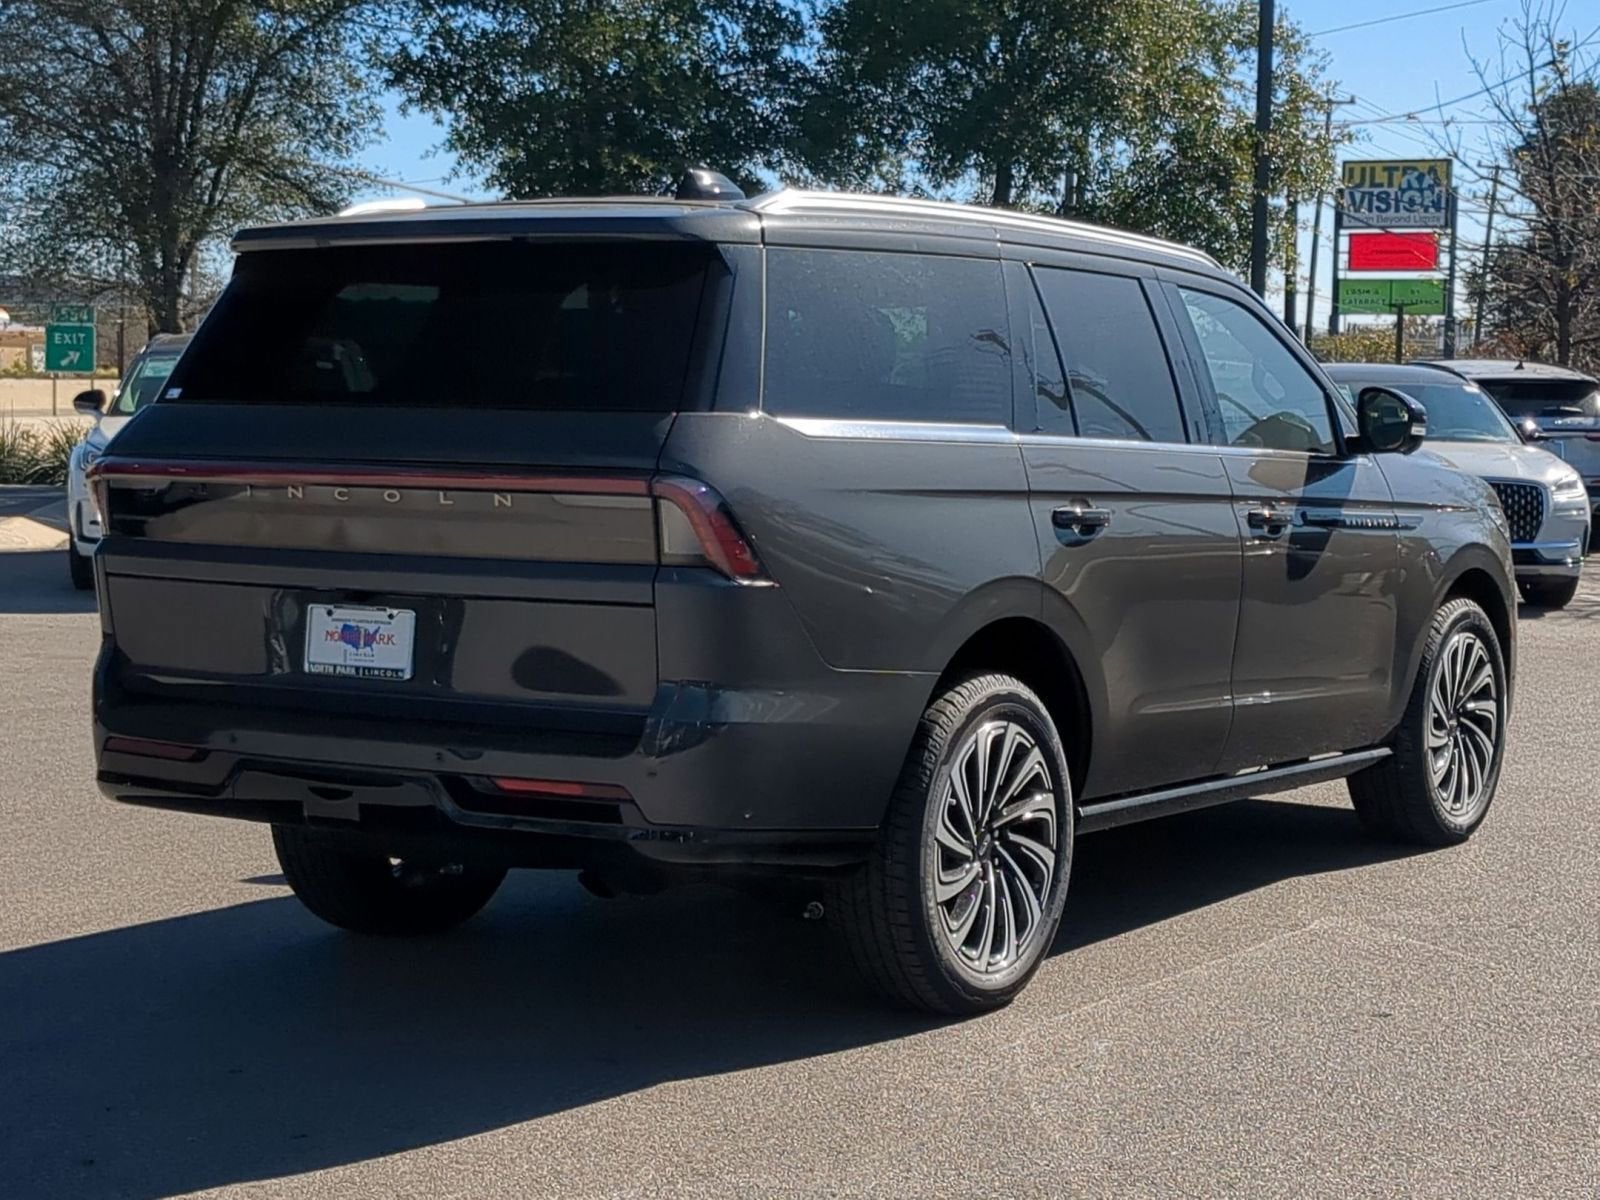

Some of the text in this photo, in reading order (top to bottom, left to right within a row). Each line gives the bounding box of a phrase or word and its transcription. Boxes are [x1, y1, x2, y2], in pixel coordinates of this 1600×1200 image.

[1347, 165, 1441, 188] ULTRA
[1348, 190, 1442, 213] VISION
[1348, 214, 1374, 223] Von
[1377, 214, 1411, 226] Beyond
[54, 333, 86, 345] EXIT
[364, 669, 405, 679] LINCOLN
